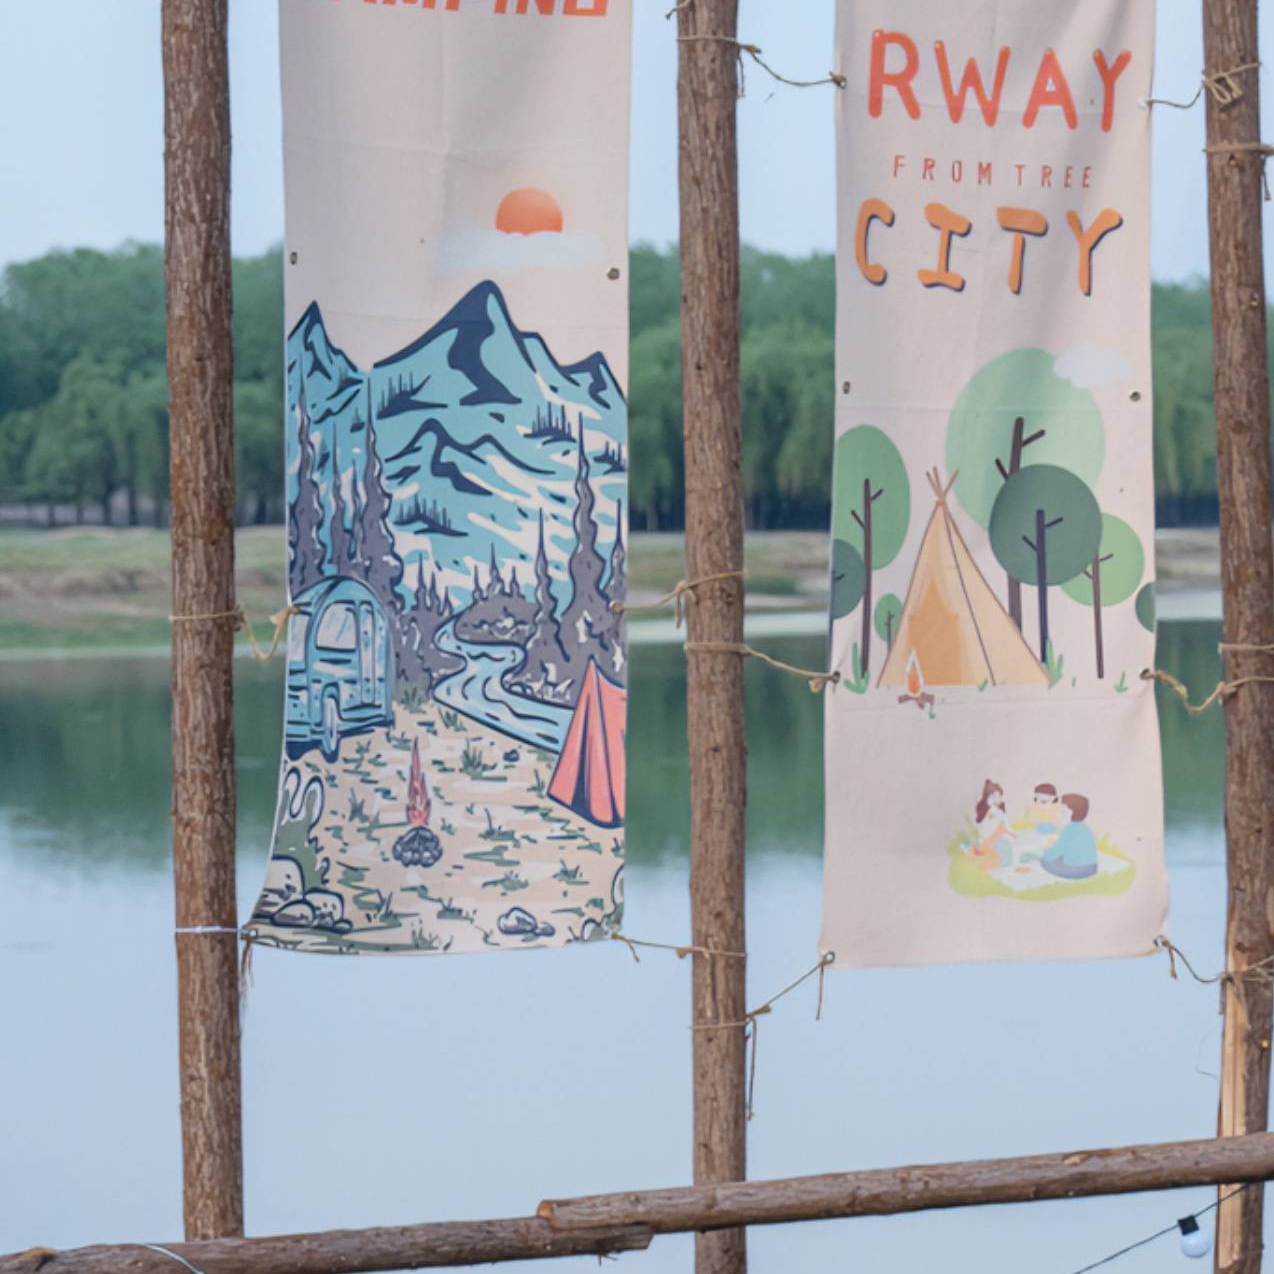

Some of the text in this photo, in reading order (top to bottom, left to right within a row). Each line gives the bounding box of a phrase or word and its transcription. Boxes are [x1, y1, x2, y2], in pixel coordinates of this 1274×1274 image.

[867, 28, 1133, 134] RWAY
[891, 153, 1092, 189] FROM TREE
[854, 197, 1123, 296] CITY
